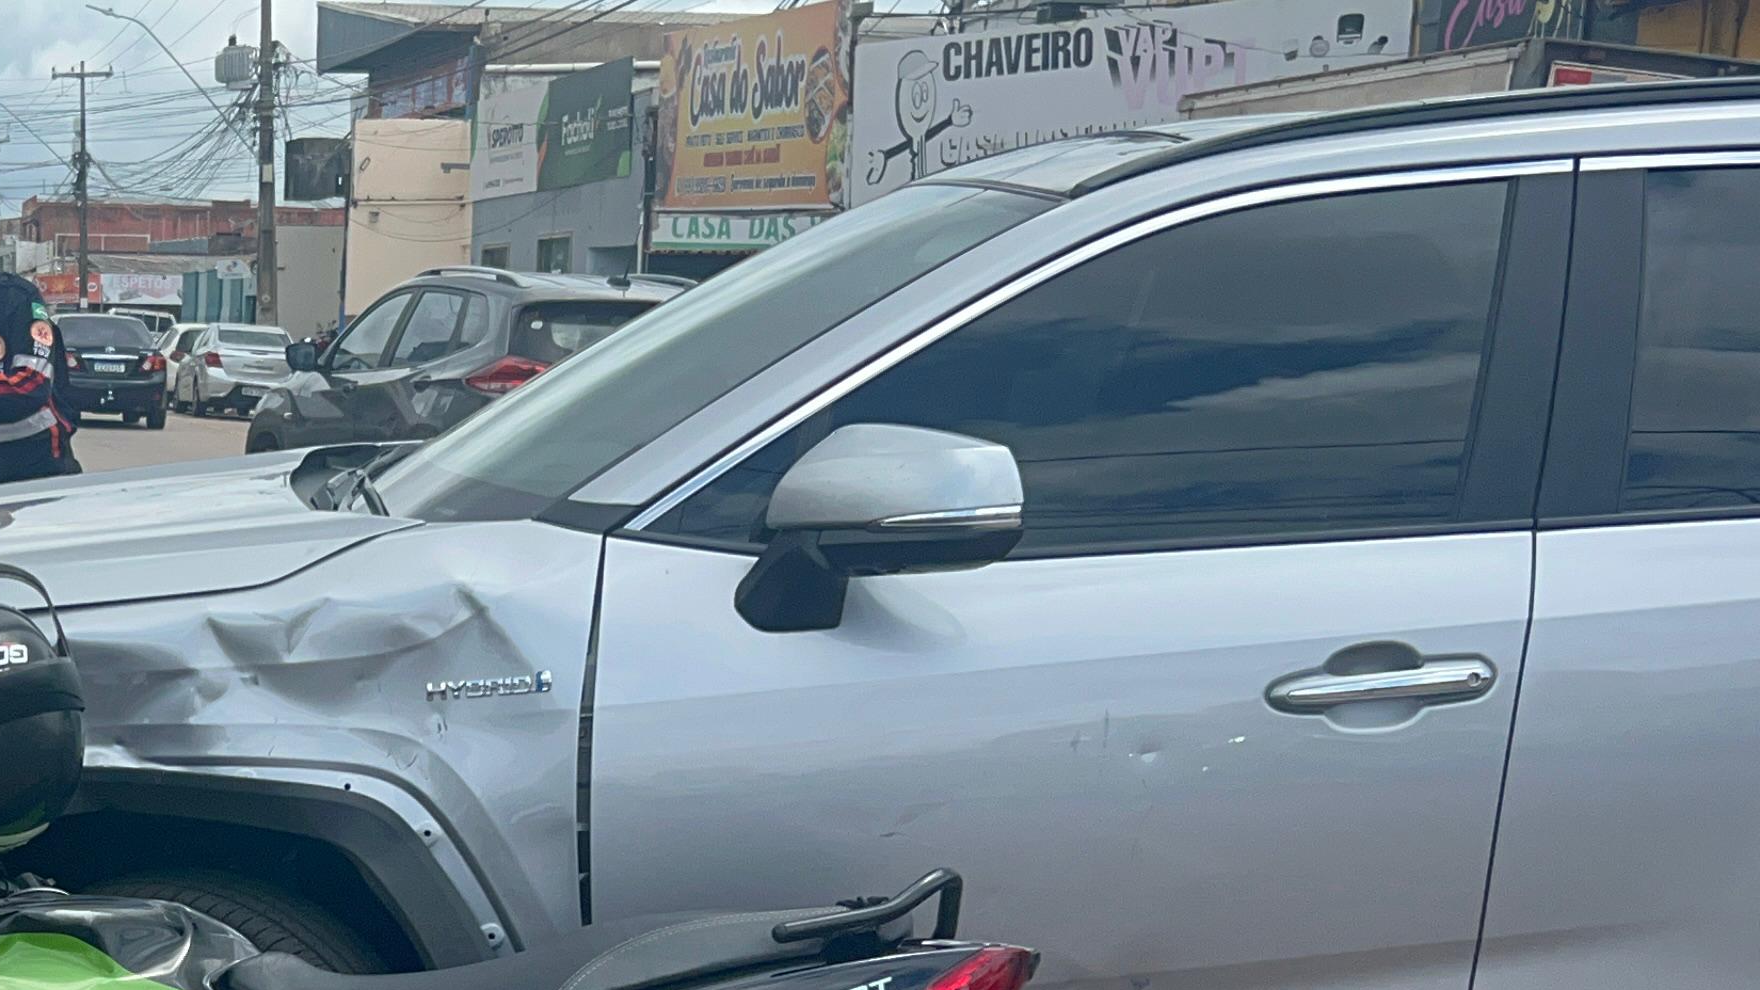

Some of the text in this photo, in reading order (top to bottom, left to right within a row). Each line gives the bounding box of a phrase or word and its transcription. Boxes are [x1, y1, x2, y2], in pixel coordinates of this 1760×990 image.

[942, 26, 1094, 82] CHAVEIRO
[690, 31, 806, 127] Casa do Sabor
[671, 216, 731, 240] CASA
[749, 215, 797, 240] DAS
[426, 674, 532, 702] HYBRID
